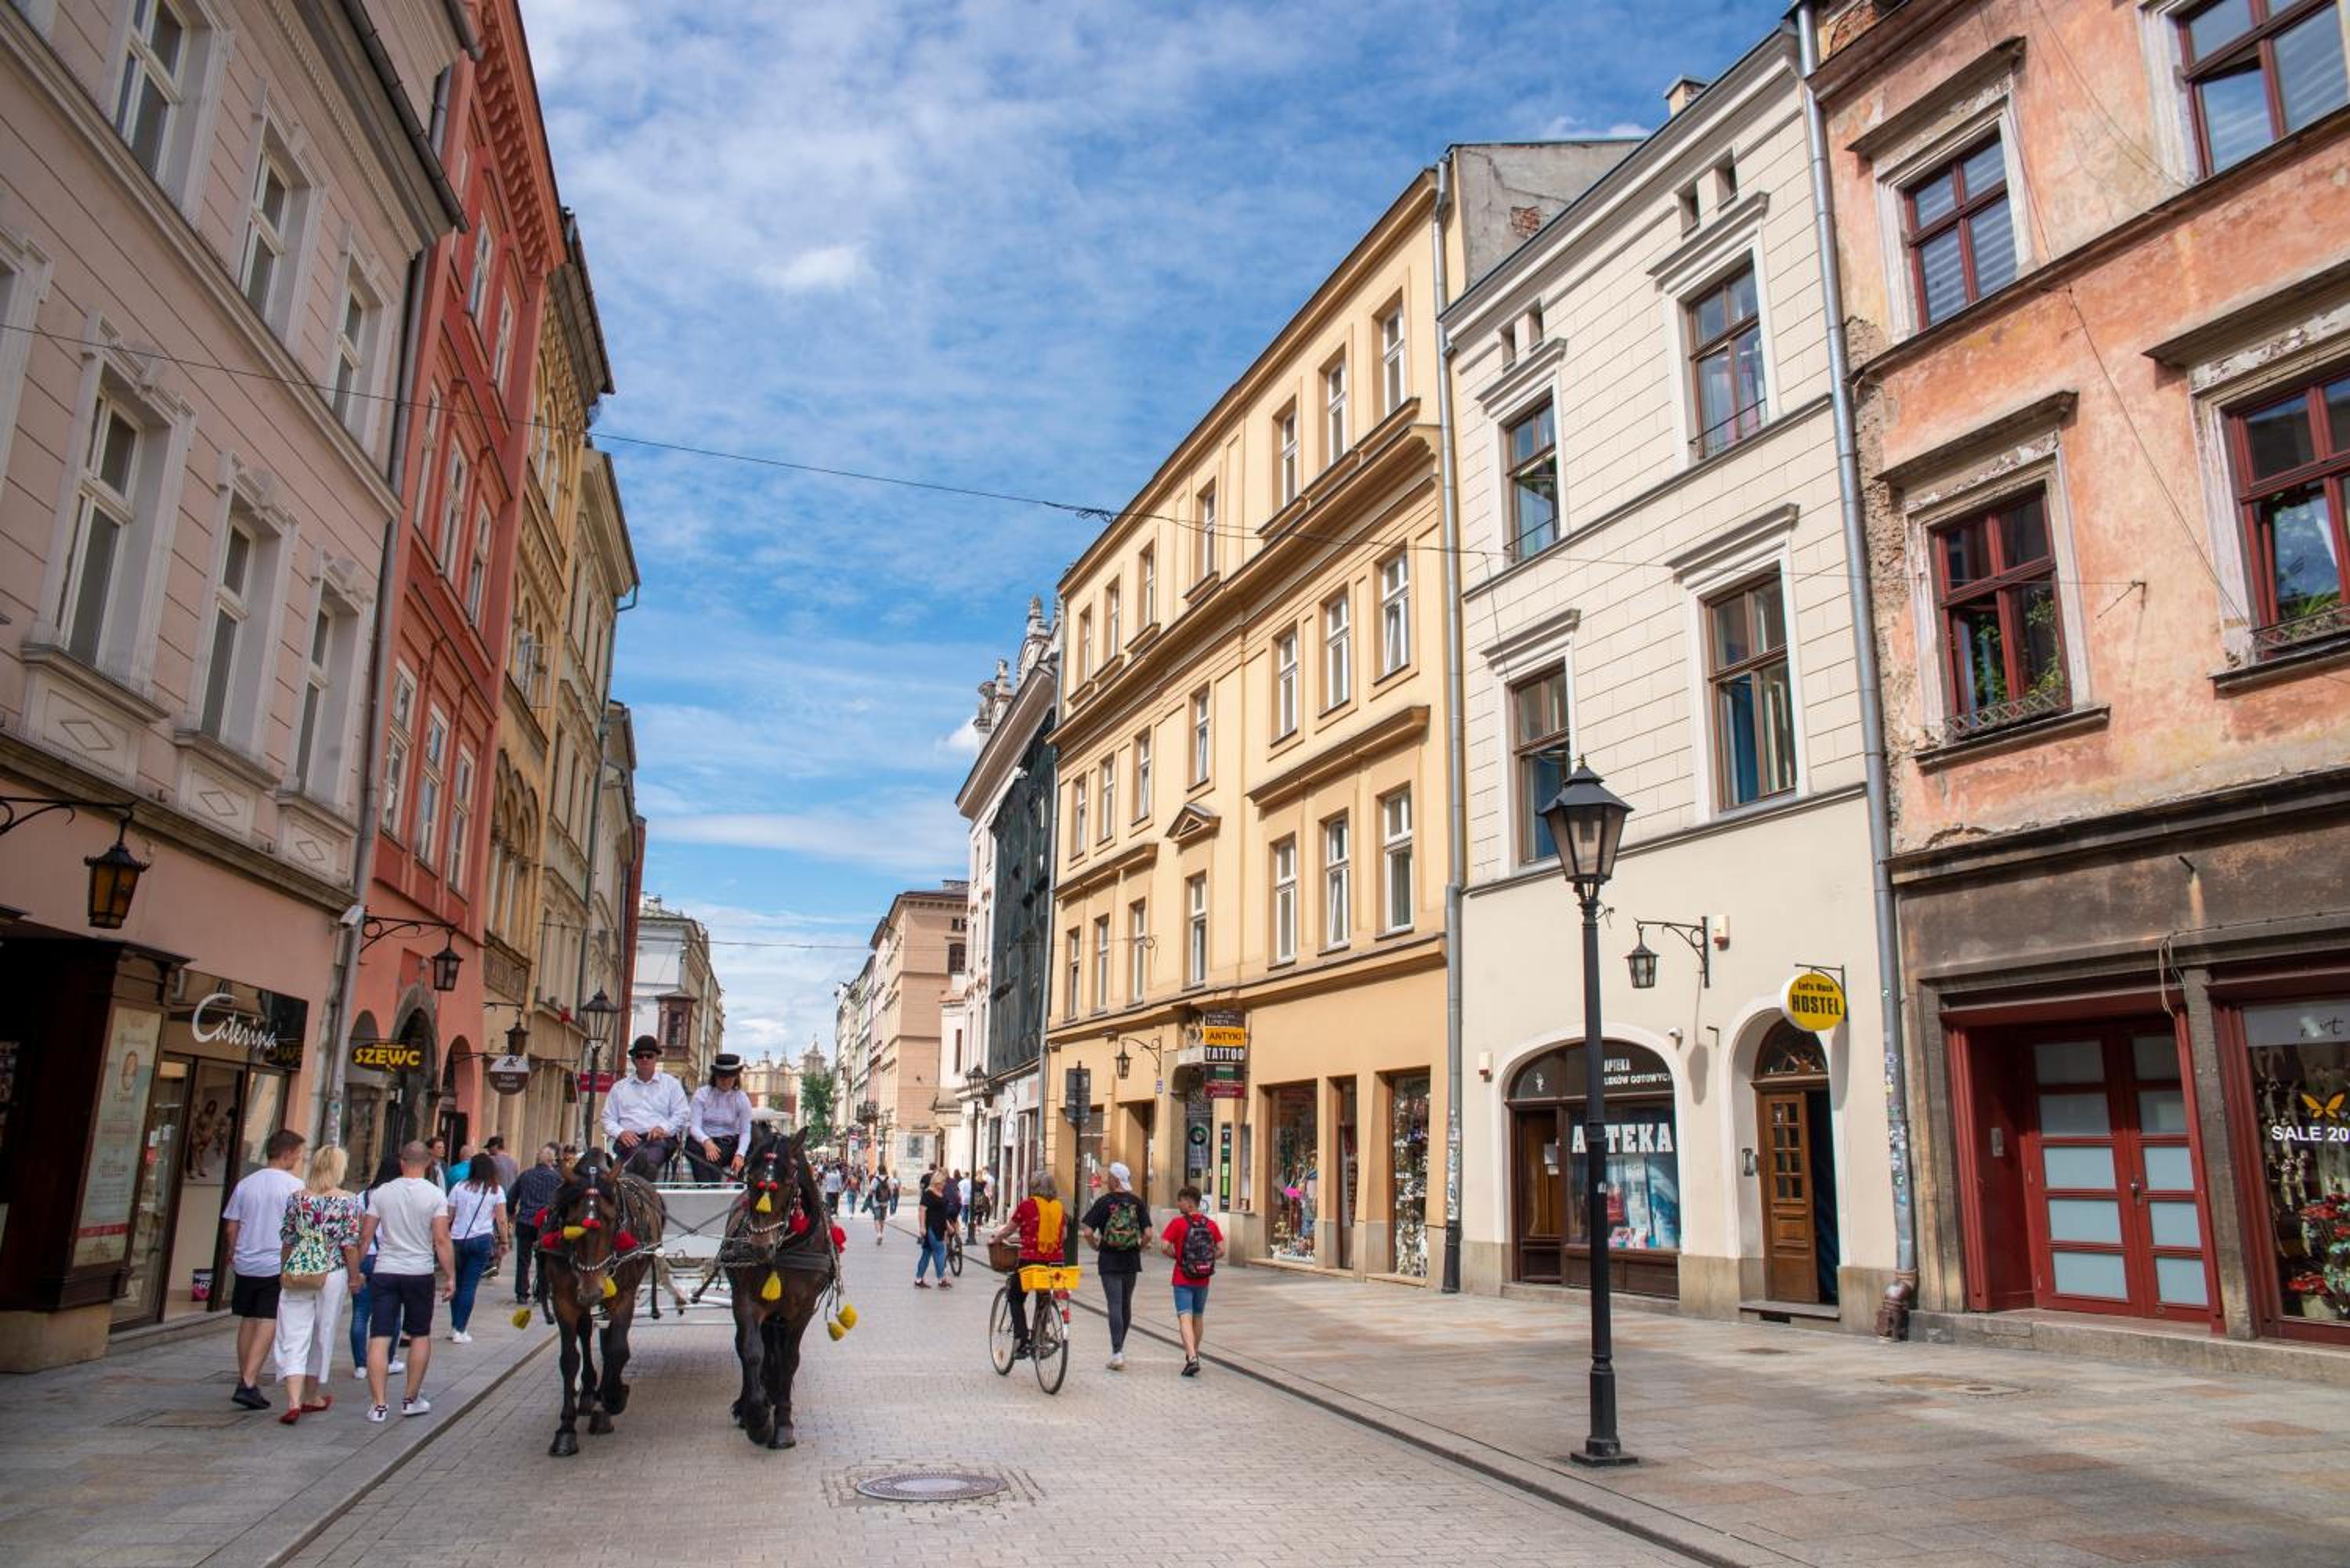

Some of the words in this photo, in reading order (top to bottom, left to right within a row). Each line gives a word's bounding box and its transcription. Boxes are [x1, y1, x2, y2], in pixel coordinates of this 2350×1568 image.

[1792, 993, 1841, 1015] HOSTEL
[192, 992, 277, 1050] Caterina
[1209, 1031, 1242, 1042] ANTYKI
[355, 1047, 421, 1066] SZEWC
[1206, 1047, 1244, 1061] TATTOO
[1571, 1122, 1674, 1154] ATEKA
[2272, 1125, 2323, 1142] SALE
